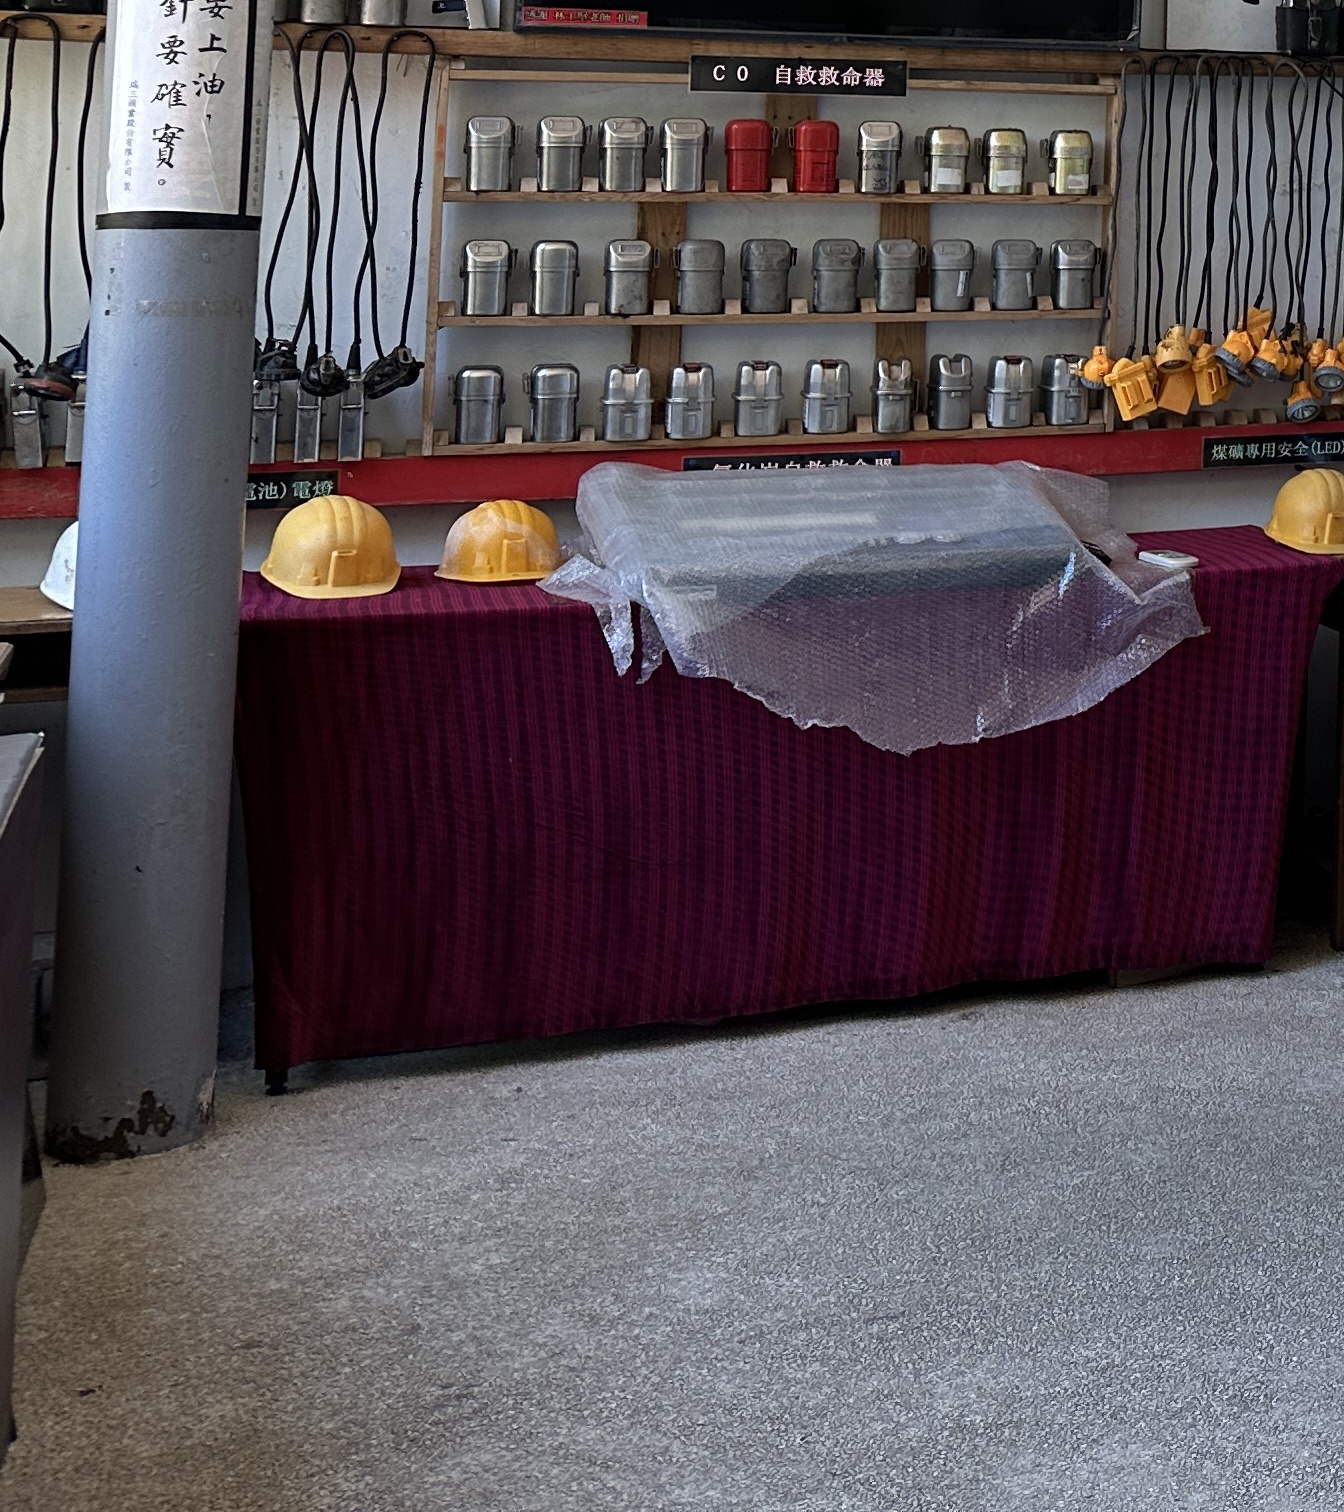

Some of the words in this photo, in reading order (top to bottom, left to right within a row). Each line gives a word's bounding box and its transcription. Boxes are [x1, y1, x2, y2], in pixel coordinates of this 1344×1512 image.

[775, 64, 886, 88] 自救救命器
